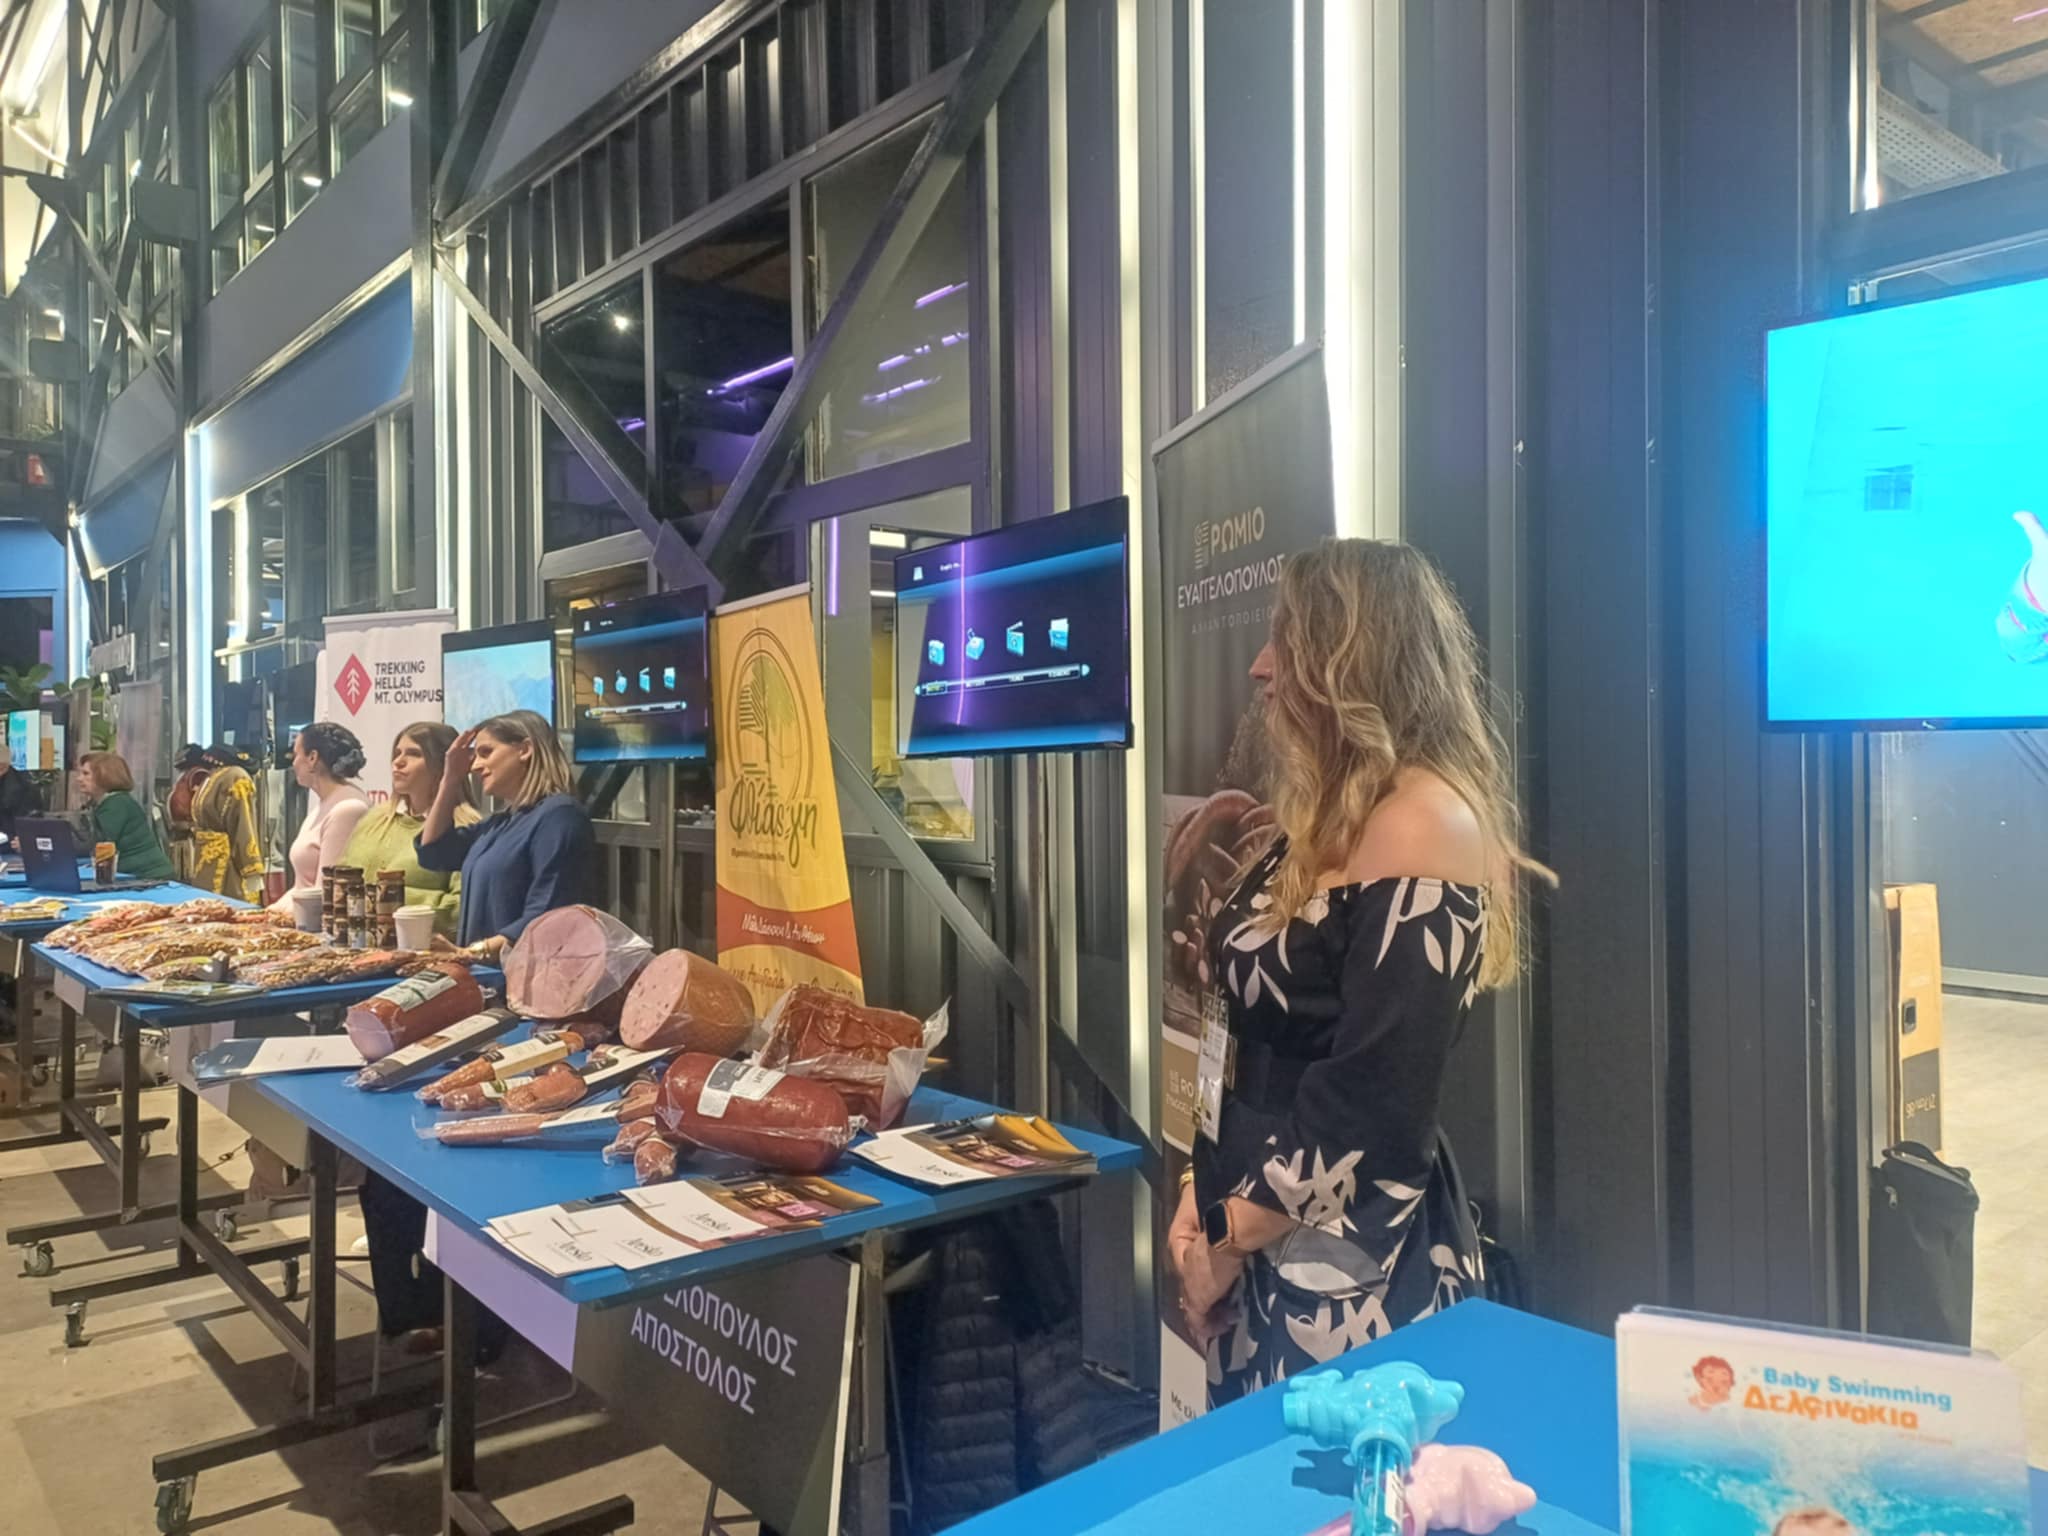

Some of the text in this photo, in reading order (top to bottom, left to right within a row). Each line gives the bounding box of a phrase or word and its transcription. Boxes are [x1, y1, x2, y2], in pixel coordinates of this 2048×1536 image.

[1211, 506, 1265, 555] ΡΩΜΙΟ
[374, 660, 426, 675] TREKKING
[374, 675, 413, 690] HELLAS
[374, 688, 444, 704] MT. OLYMPUS
[630, 1307, 757, 1415] ΑΠΟΣΤΟΛΟΣ
[1763, 1366, 1952, 1412] Baby Swimming
